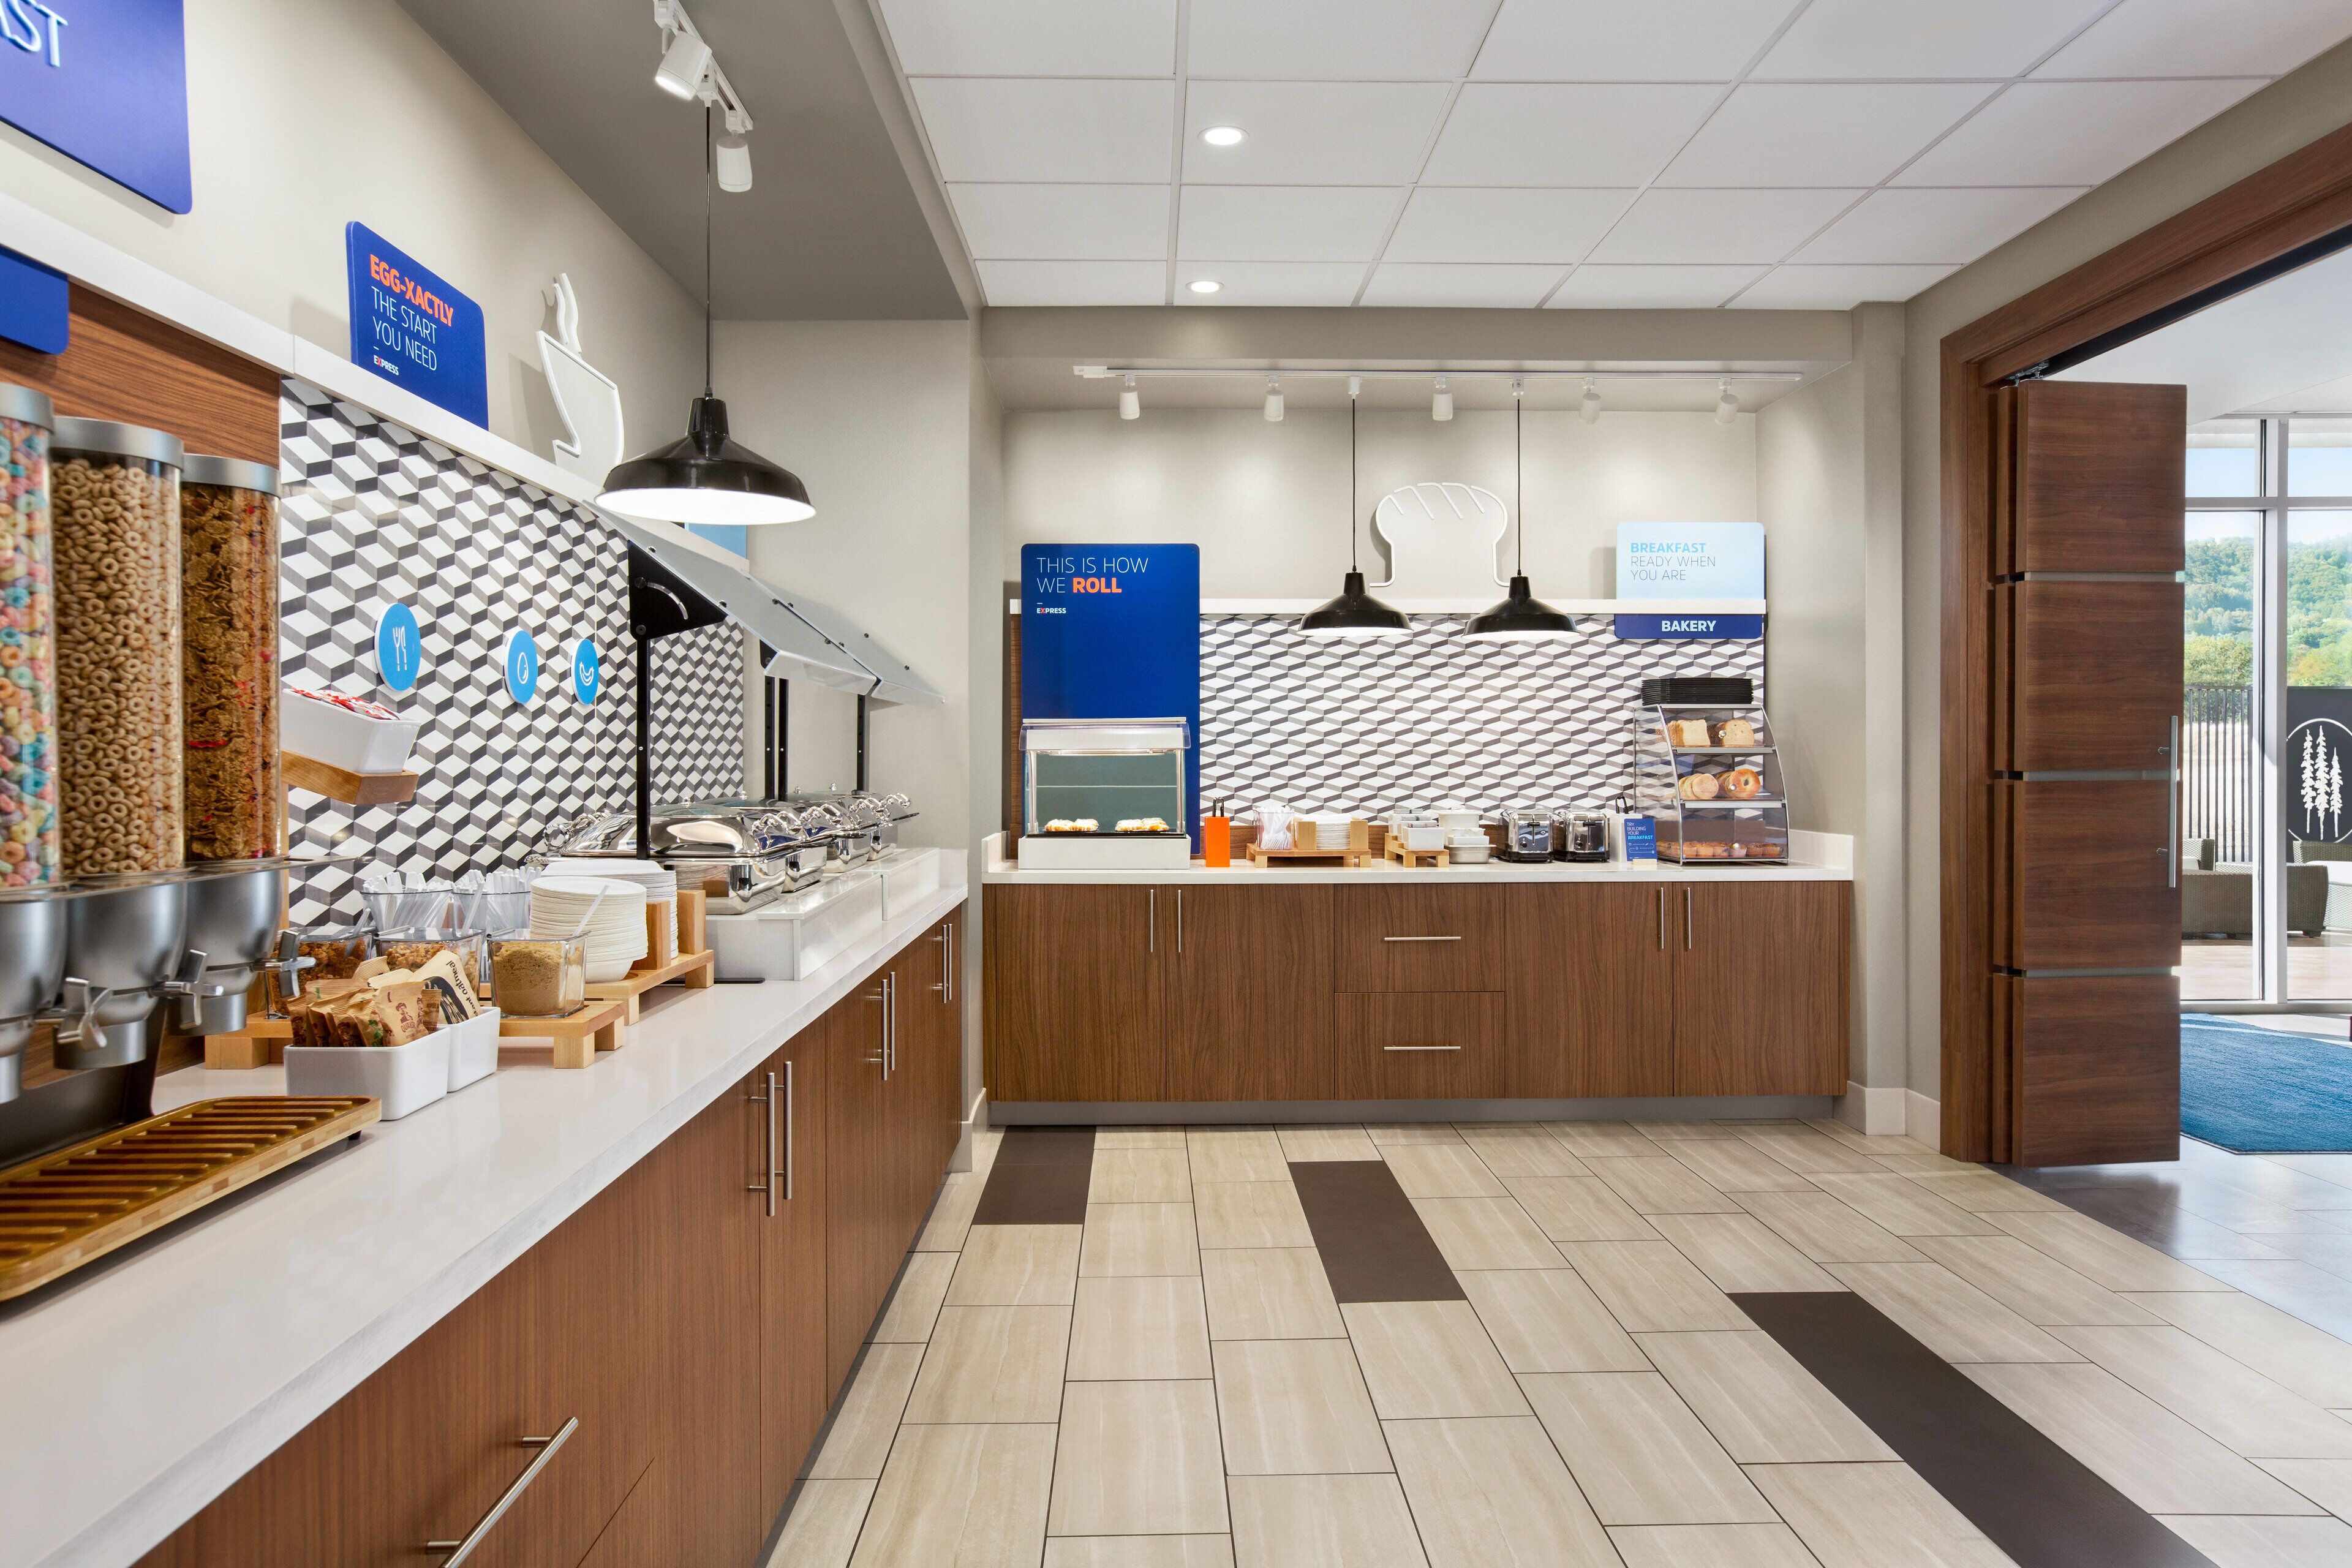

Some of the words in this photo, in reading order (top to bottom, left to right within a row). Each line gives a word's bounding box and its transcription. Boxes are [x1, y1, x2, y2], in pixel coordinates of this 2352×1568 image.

[370, 254, 454, 327] EGG-XACTLY
[371, 285, 397, 322] THE
[401, 305, 437, 344] START
[372, 315, 401, 351] YOU
[405, 335, 437, 371] NEED
[373, 355, 399, 375] EXPRESS
[1630, 542, 1706, 554] BREAKFAST
[1036, 557, 1075, 573] THIS
[1082, 557, 1096, 573] IS
[1103, 557, 1149, 573] HOW
[1630, 556, 1673, 567] READY
[1677, 556, 1716, 567] WHEN
[1630, 569, 1657, 581] YOU
[1662, 569, 1686, 581] ARE
[1036, 577, 1066, 594] WE
[1072, 577, 1122, 594] ROLL
[1661, 620, 1717, 632] BAKERY
[446, 960, 468, 995] oatmeal
